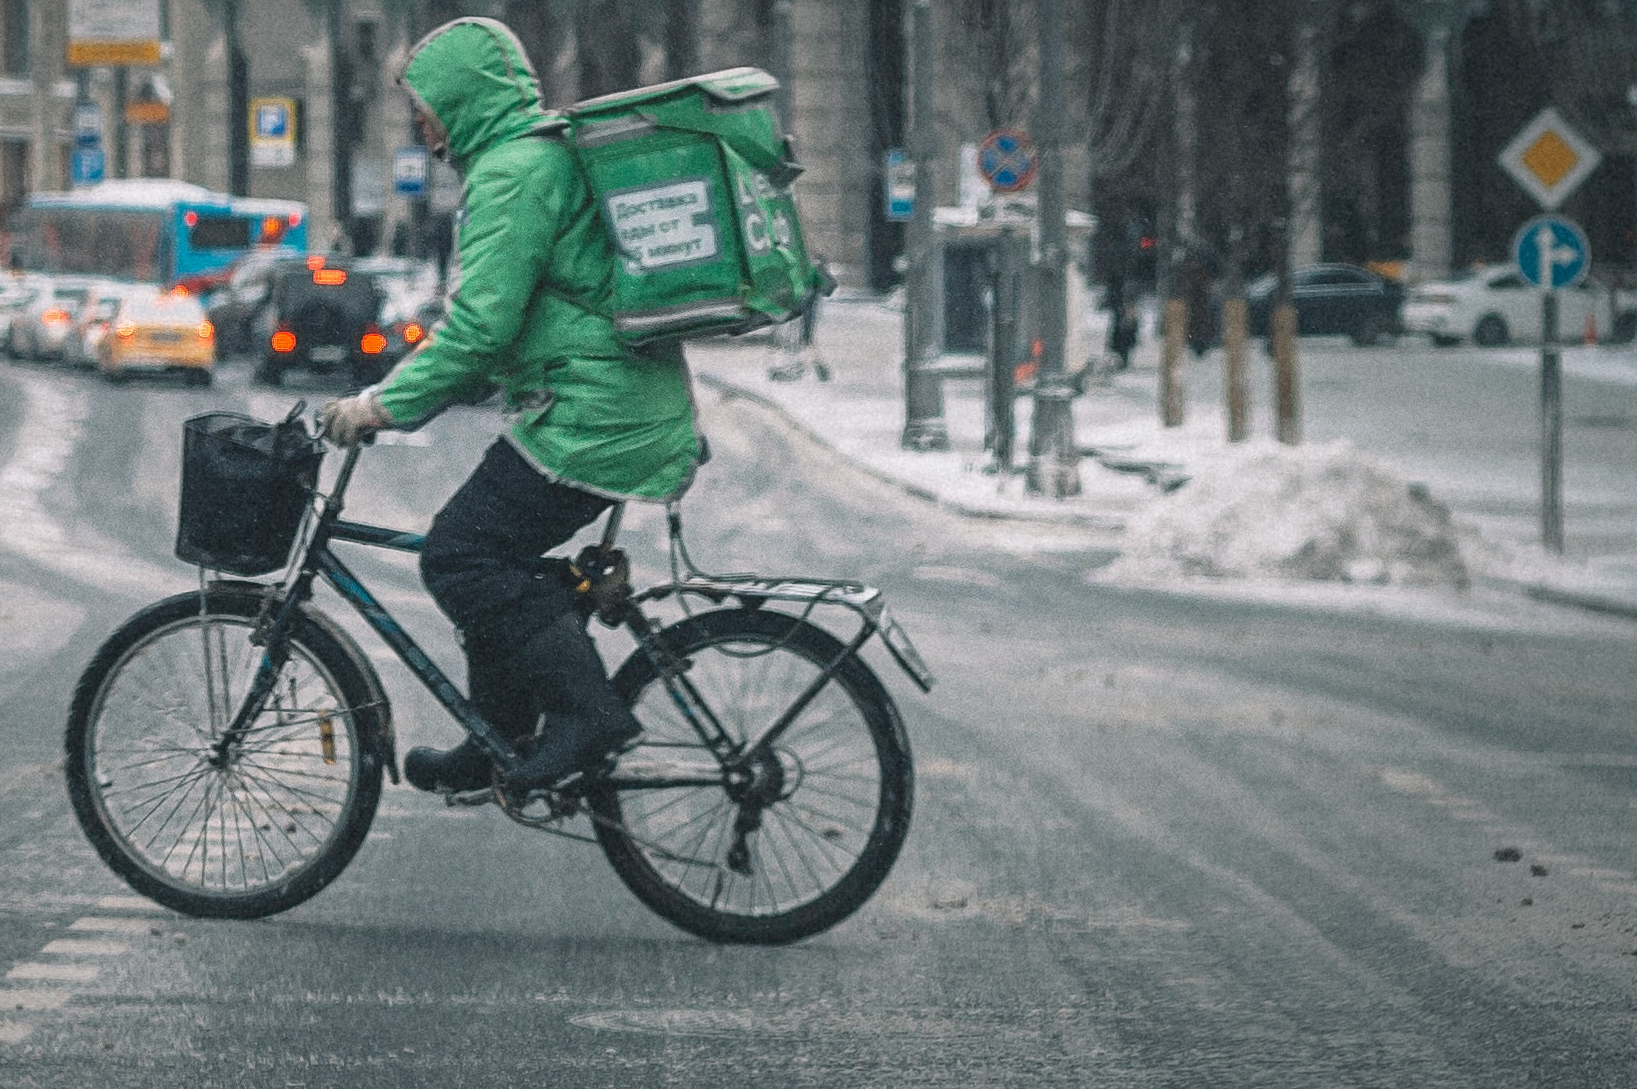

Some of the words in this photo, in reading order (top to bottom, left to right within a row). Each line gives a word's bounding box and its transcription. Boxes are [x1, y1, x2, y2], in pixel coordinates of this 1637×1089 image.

[616, 193, 698, 220] Доставка
[658, 219, 681, 233] от
[647, 238, 702, 257] минут
